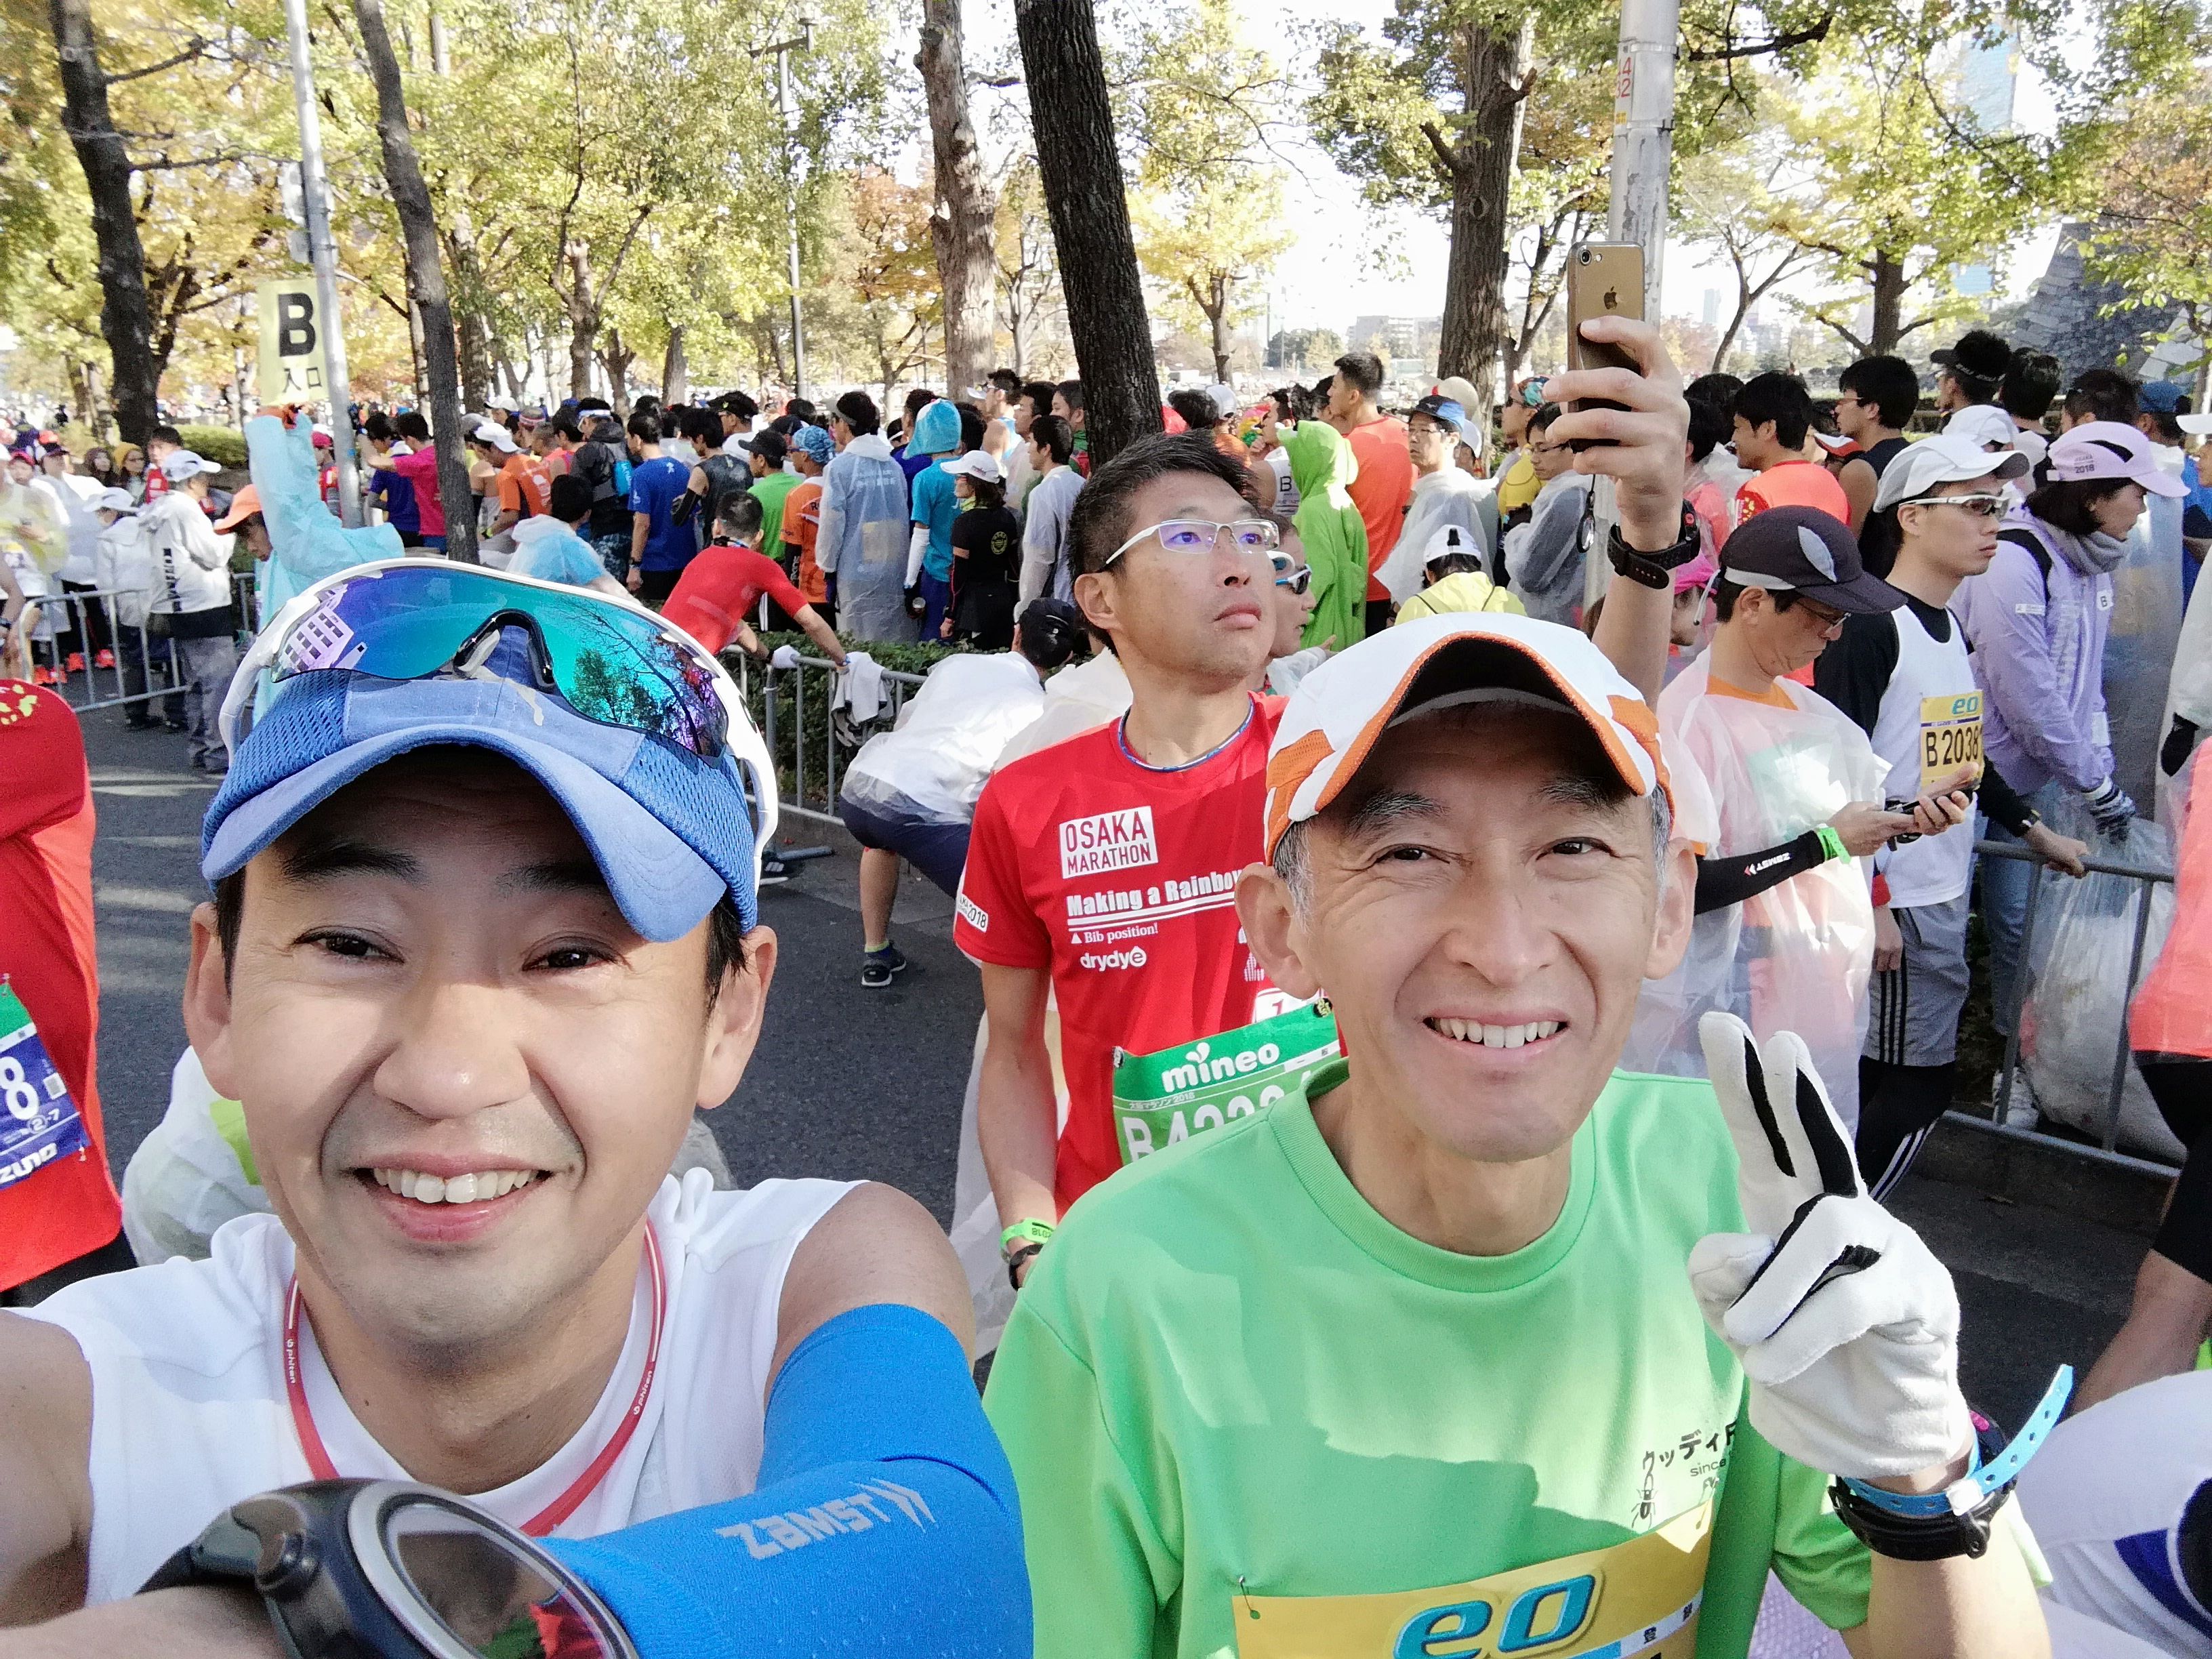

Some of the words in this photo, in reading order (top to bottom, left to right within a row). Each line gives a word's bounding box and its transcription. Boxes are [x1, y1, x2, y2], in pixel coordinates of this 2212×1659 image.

[278, 293, 316, 357] B
[283, 367, 323, 393] 入口
[1951, 696, 1979, 715] eo
[1065, 811, 1147, 852] OSAKA
[1067, 842, 1151, 875] MARATHON
[1066, 890, 1143, 916] Making
[1147, 886, 1160, 905] a
[1083, 930, 1105, 944] Bib
[1107, 922, 1159, 944] position!
[1080, 945, 1147, 972] drydye
[1162, 1042, 1279, 1092] mineo
[1690, 1458, 1726, 1477] since
[1394, 1574, 1595, 1659] eo
